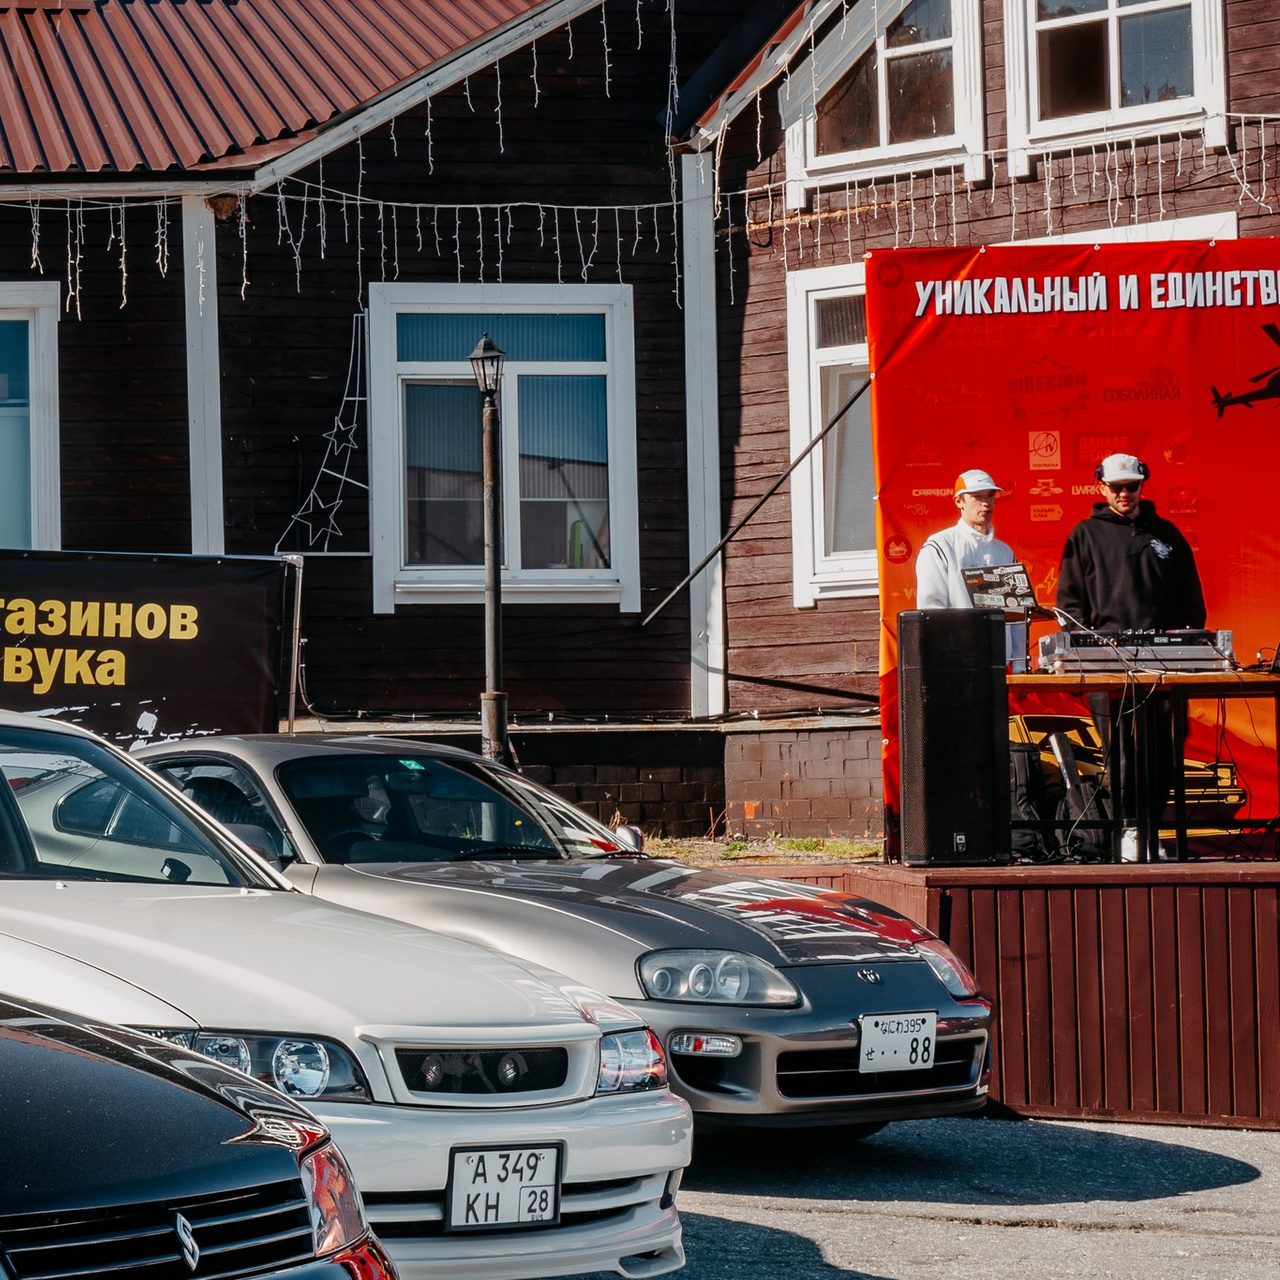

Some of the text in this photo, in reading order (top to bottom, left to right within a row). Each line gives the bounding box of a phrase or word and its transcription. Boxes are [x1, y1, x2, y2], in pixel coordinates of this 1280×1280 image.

[915, 270, 1280, 317] УНИКАЛЬНЫЙ И ЕДИНСТВ
[1103, 387, 1181, 402] СОБОЛИНАЯ
[912, 488, 954, 497] CARBON
[909, 1036, 931, 1065] 88
[497, 1152, 539, 1183] 349
[527, 1189, 549, 1213] 28
